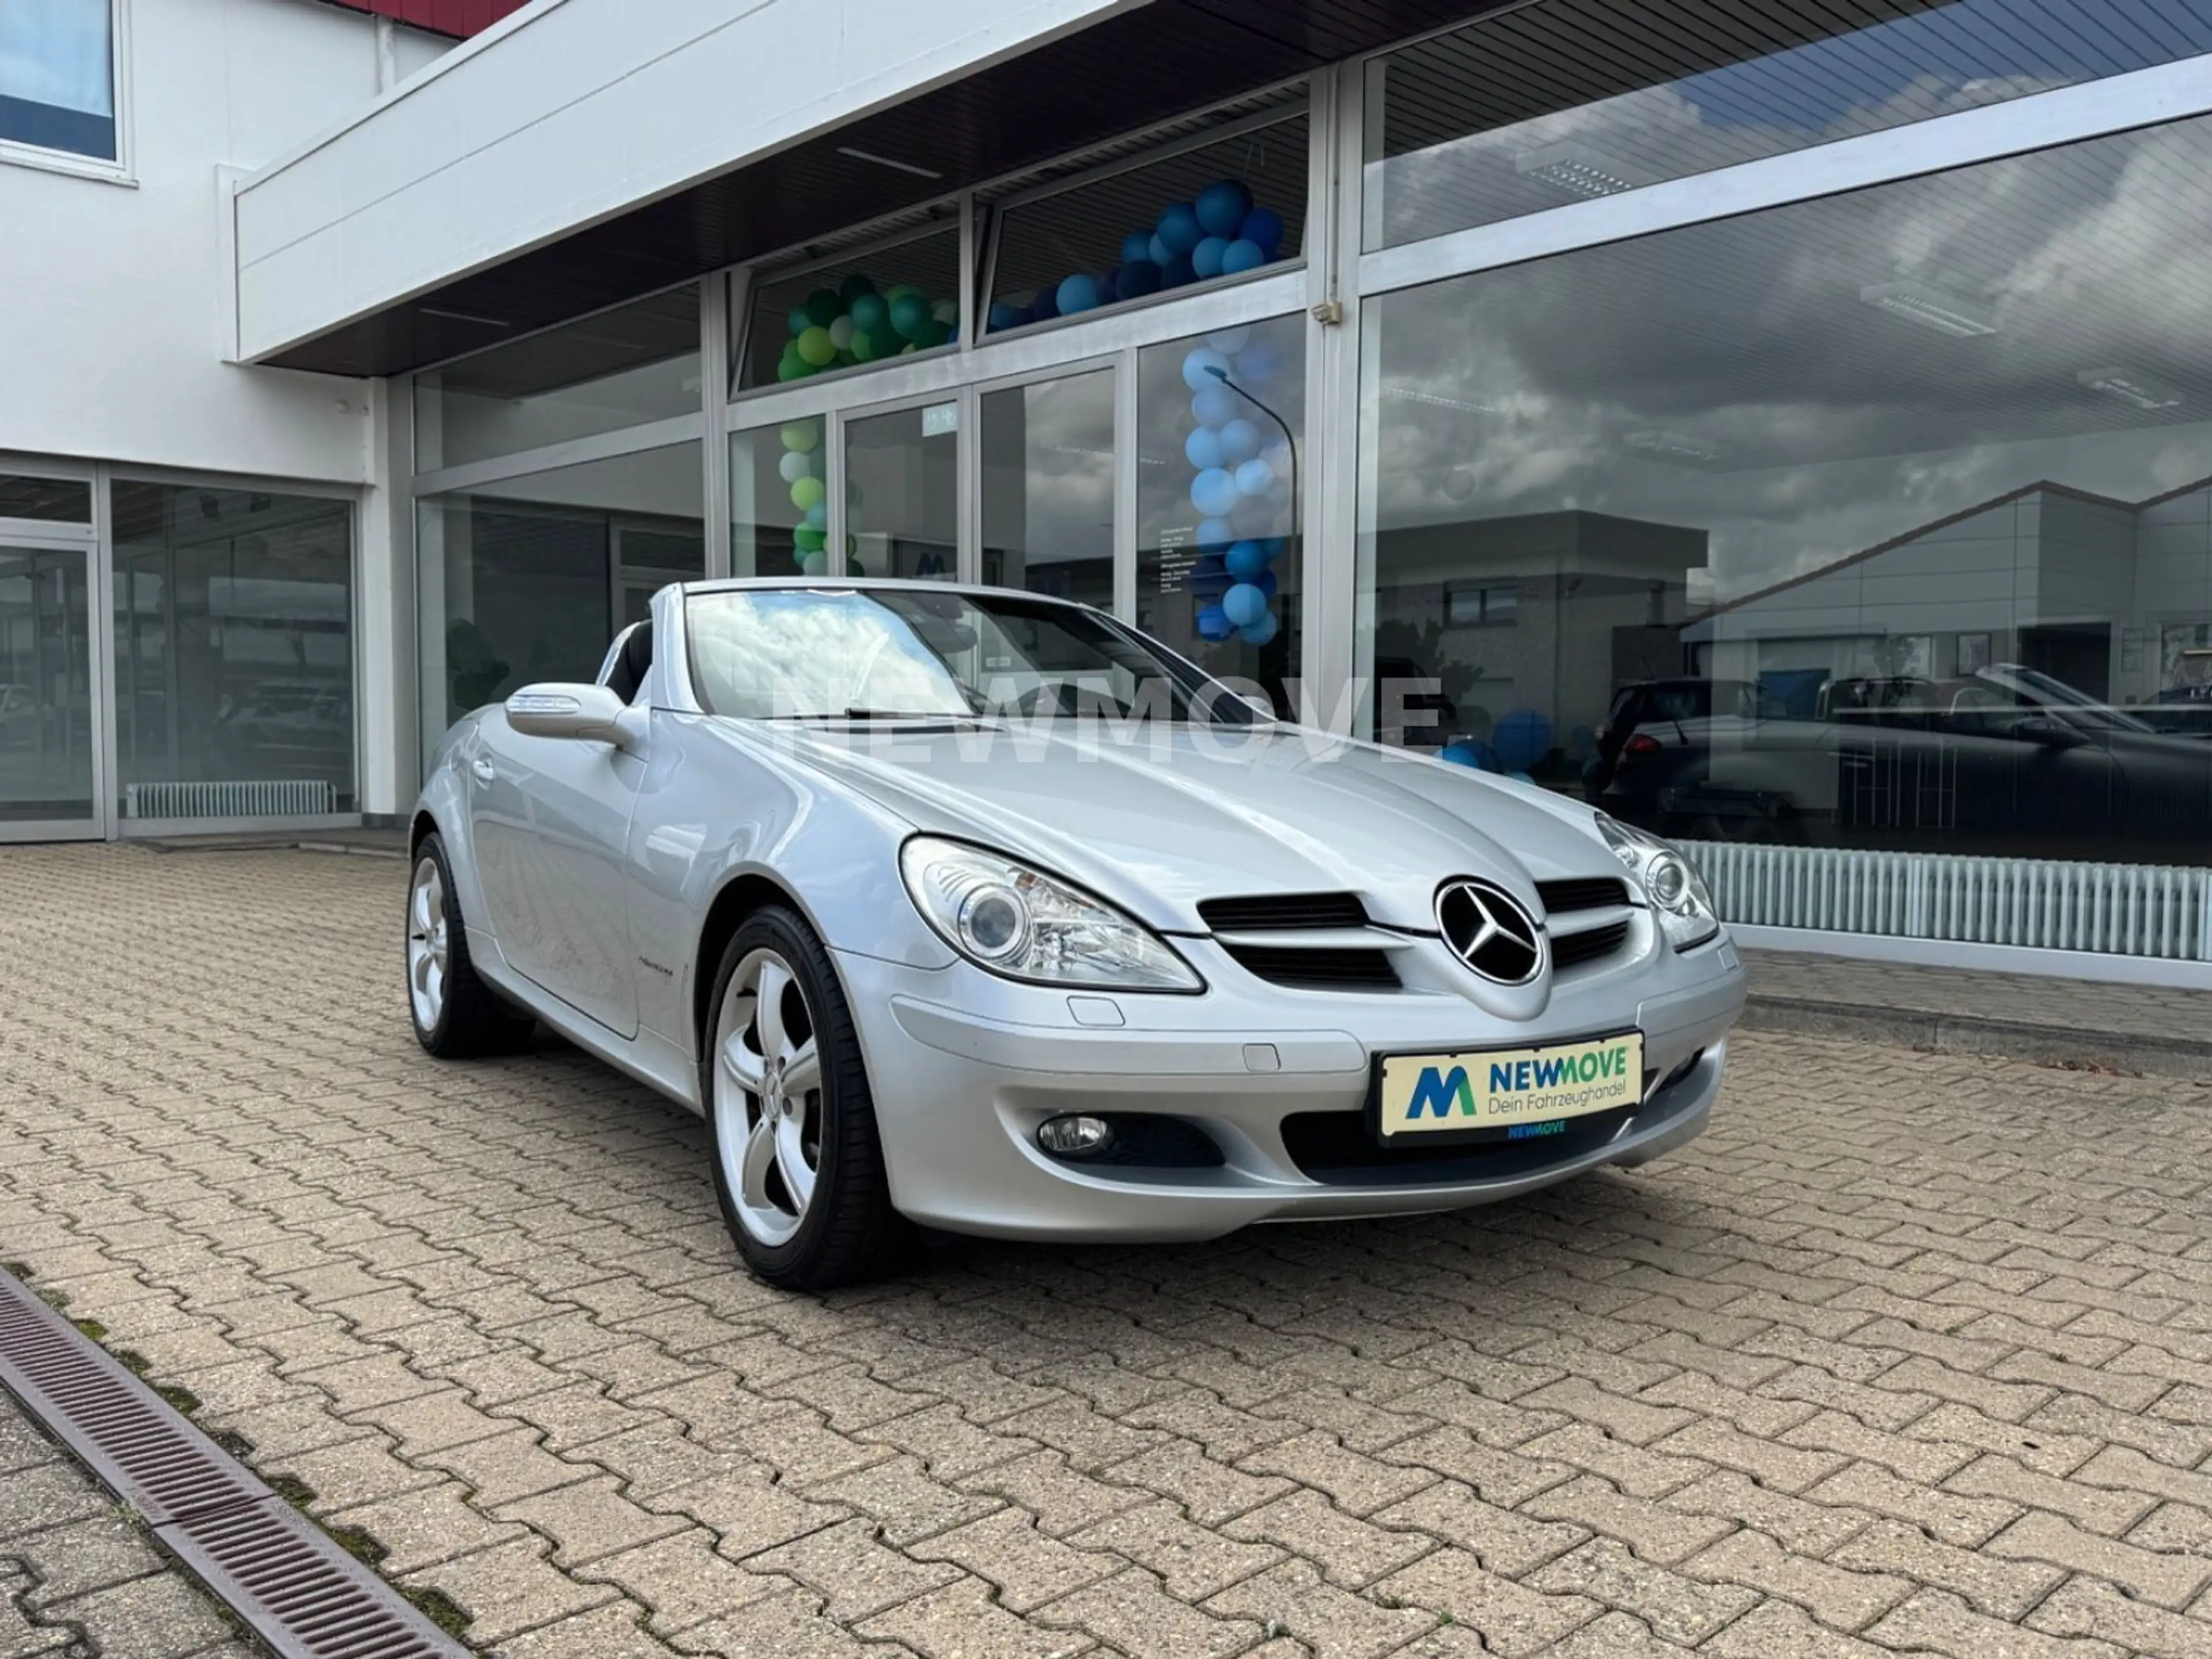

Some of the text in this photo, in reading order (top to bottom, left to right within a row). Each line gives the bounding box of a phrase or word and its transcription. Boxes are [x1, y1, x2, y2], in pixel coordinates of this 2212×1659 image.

[1490, 1046, 1626, 1094] NEWMOVE
[1488, 1078, 1626, 1115] Dein Fahrzeughandel
[1508, 1120, 1567, 1139] NEWMOVE
